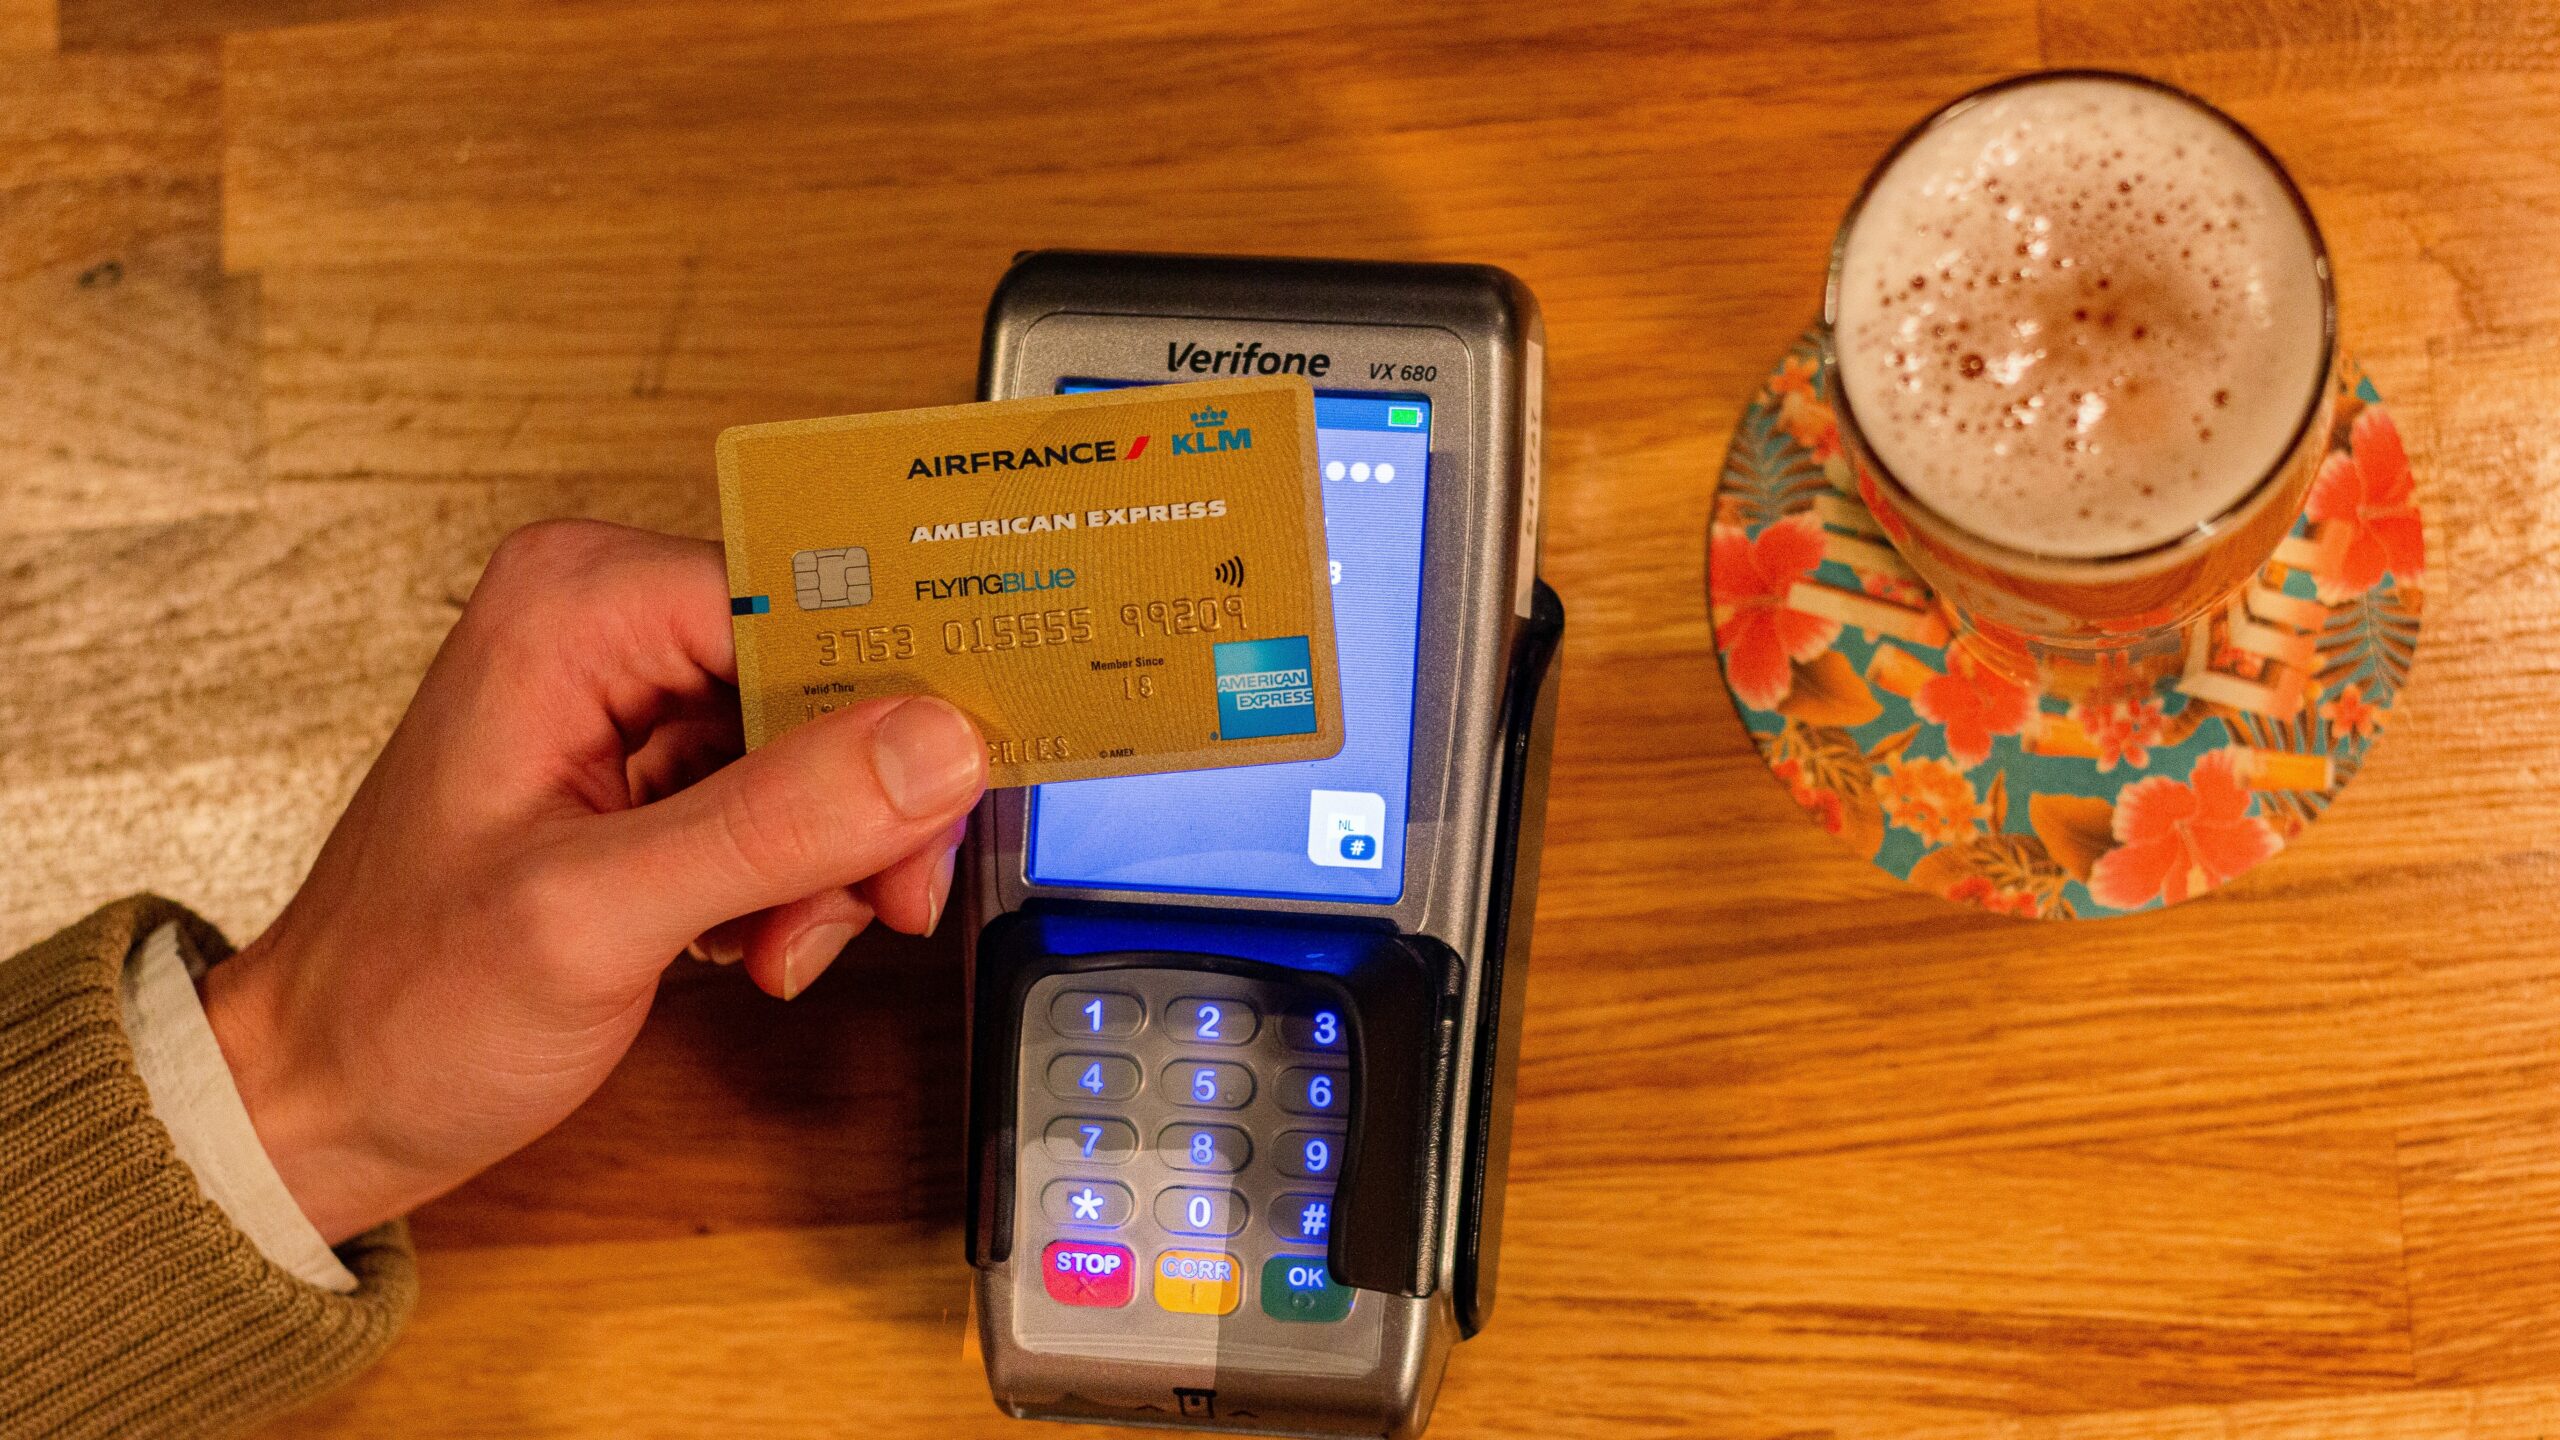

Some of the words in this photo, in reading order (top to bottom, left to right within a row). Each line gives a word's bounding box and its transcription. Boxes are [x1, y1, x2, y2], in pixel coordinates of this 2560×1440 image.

[1166, 342, 1331, 378] Verifone
[1369, 362, 1395, 380] VX
[1400, 364, 1438, 382] 680
[1172, 427, 1251, 455] KLM
[908, 441, 1117, 480] AIRFRANCE
[911, 513, 1076, 543] AMERICAN
[1086, 500, 1227, 528] EXPRESS
[817, 624, 916, 666] 3753
[942, 607, 1092, 655] 015555
[1121, 595, 1247, 637] 99209
[1091, 659, 1132, 671] Member
[1135, 656, 1164, 667] Since
[803, 684, 829, 695] Valid
[832, 682, 854, 692] Thru
[1123, 675, 1153, 699] 18
[1217, 671, 1305, 690] AMERICAN
[1239, 690, 1314, 708] EXPRESS
[1109, 747, 1135, 758] AMEX
[1338, 819, 1355, 832] NL
[1085, 999, 1102, 1032] 1
[1197, 1006, 1220, 1038] 2
[1314, 1013, 1337, 1044] 3
[1080, 1063, 1104, 1094] 4
[1194, 1070, 1216, 1101] 5
[1309, 1076, 1332, 1107] 6
[1080, 1126, 1102, 1157] 7
[1190, 1133, 1213, 1164] 8
[1306, 1140, 1328, 1171] 9
[1188, 1196, 1212, 1228] 0
[1056, 1252, 1121, 1275] STOP
[1161, 1258, 1231, 1281] CORR
[1288, 1266, 1325, 1288] OK
